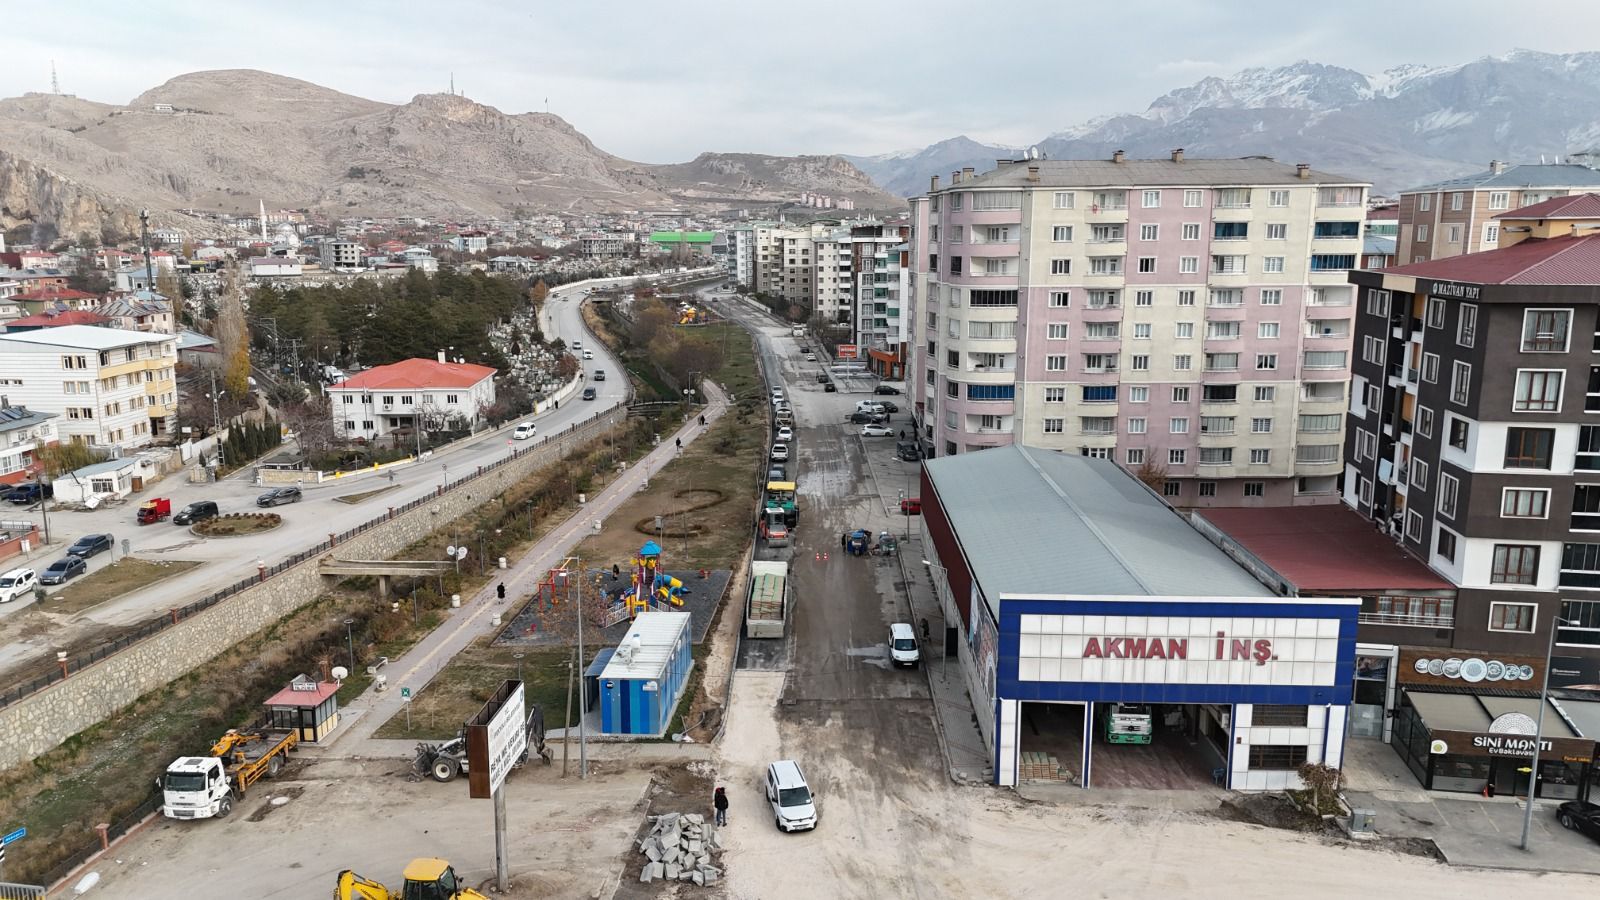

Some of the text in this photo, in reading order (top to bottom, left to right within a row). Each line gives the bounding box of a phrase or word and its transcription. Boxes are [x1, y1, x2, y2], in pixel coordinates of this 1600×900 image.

[1466, 287, 1480, 299] YAPI
[1082, 637, 1188, 659] AKMAN
[1505, 738, 1553, 751] MANTI
